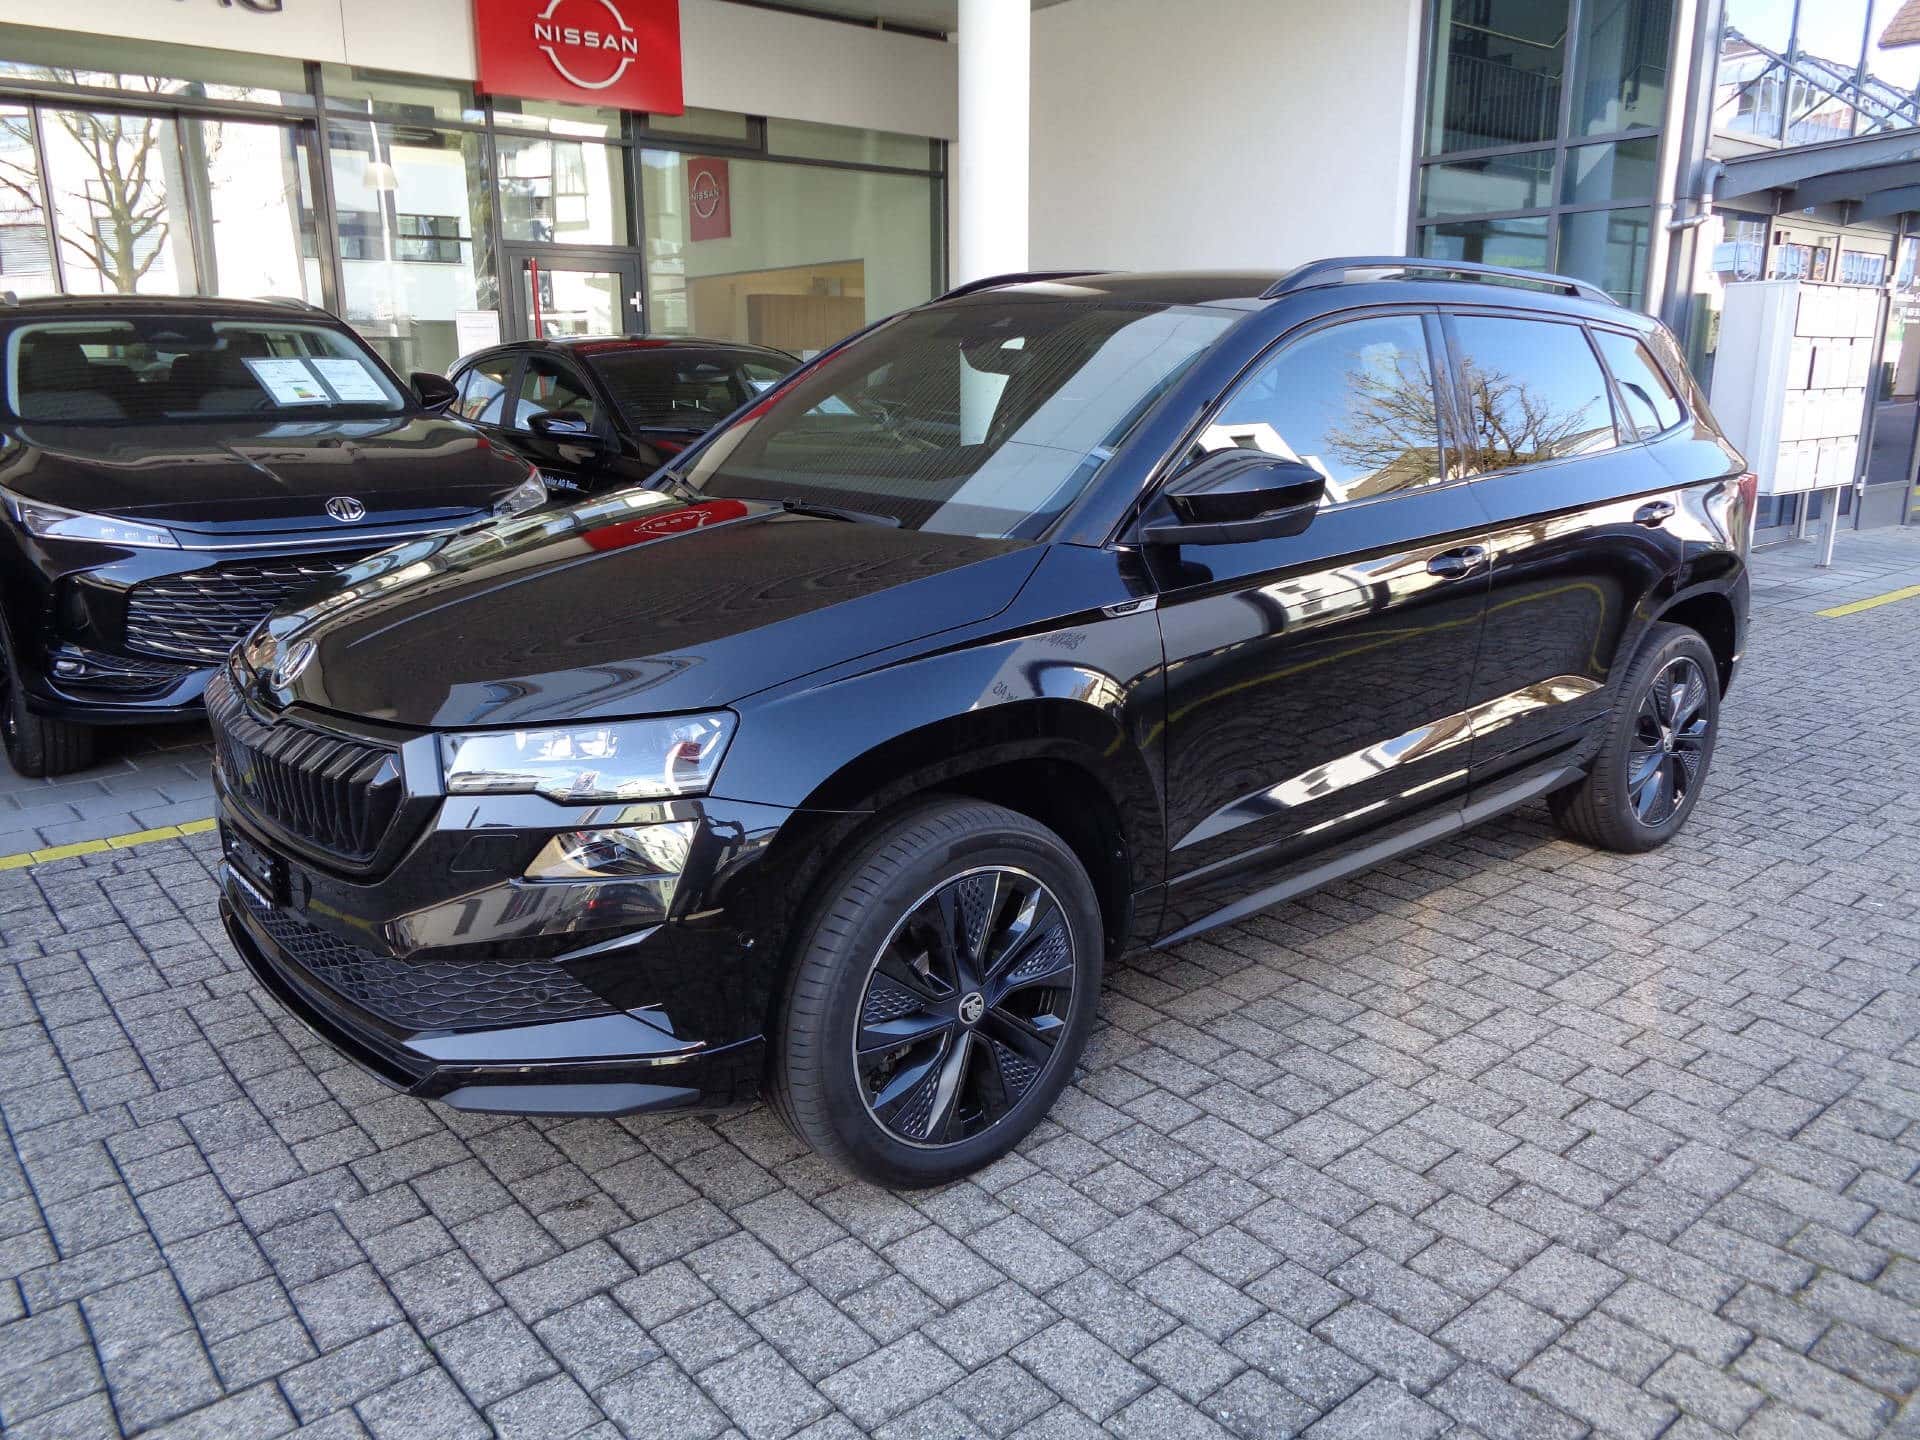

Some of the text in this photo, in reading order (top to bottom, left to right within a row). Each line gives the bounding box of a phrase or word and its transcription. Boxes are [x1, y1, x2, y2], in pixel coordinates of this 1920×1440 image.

[534, 23, 638, 54] NISSAN
[690, 187, 719, 200] NISSAN
[328, 498, 364, 520] MG
